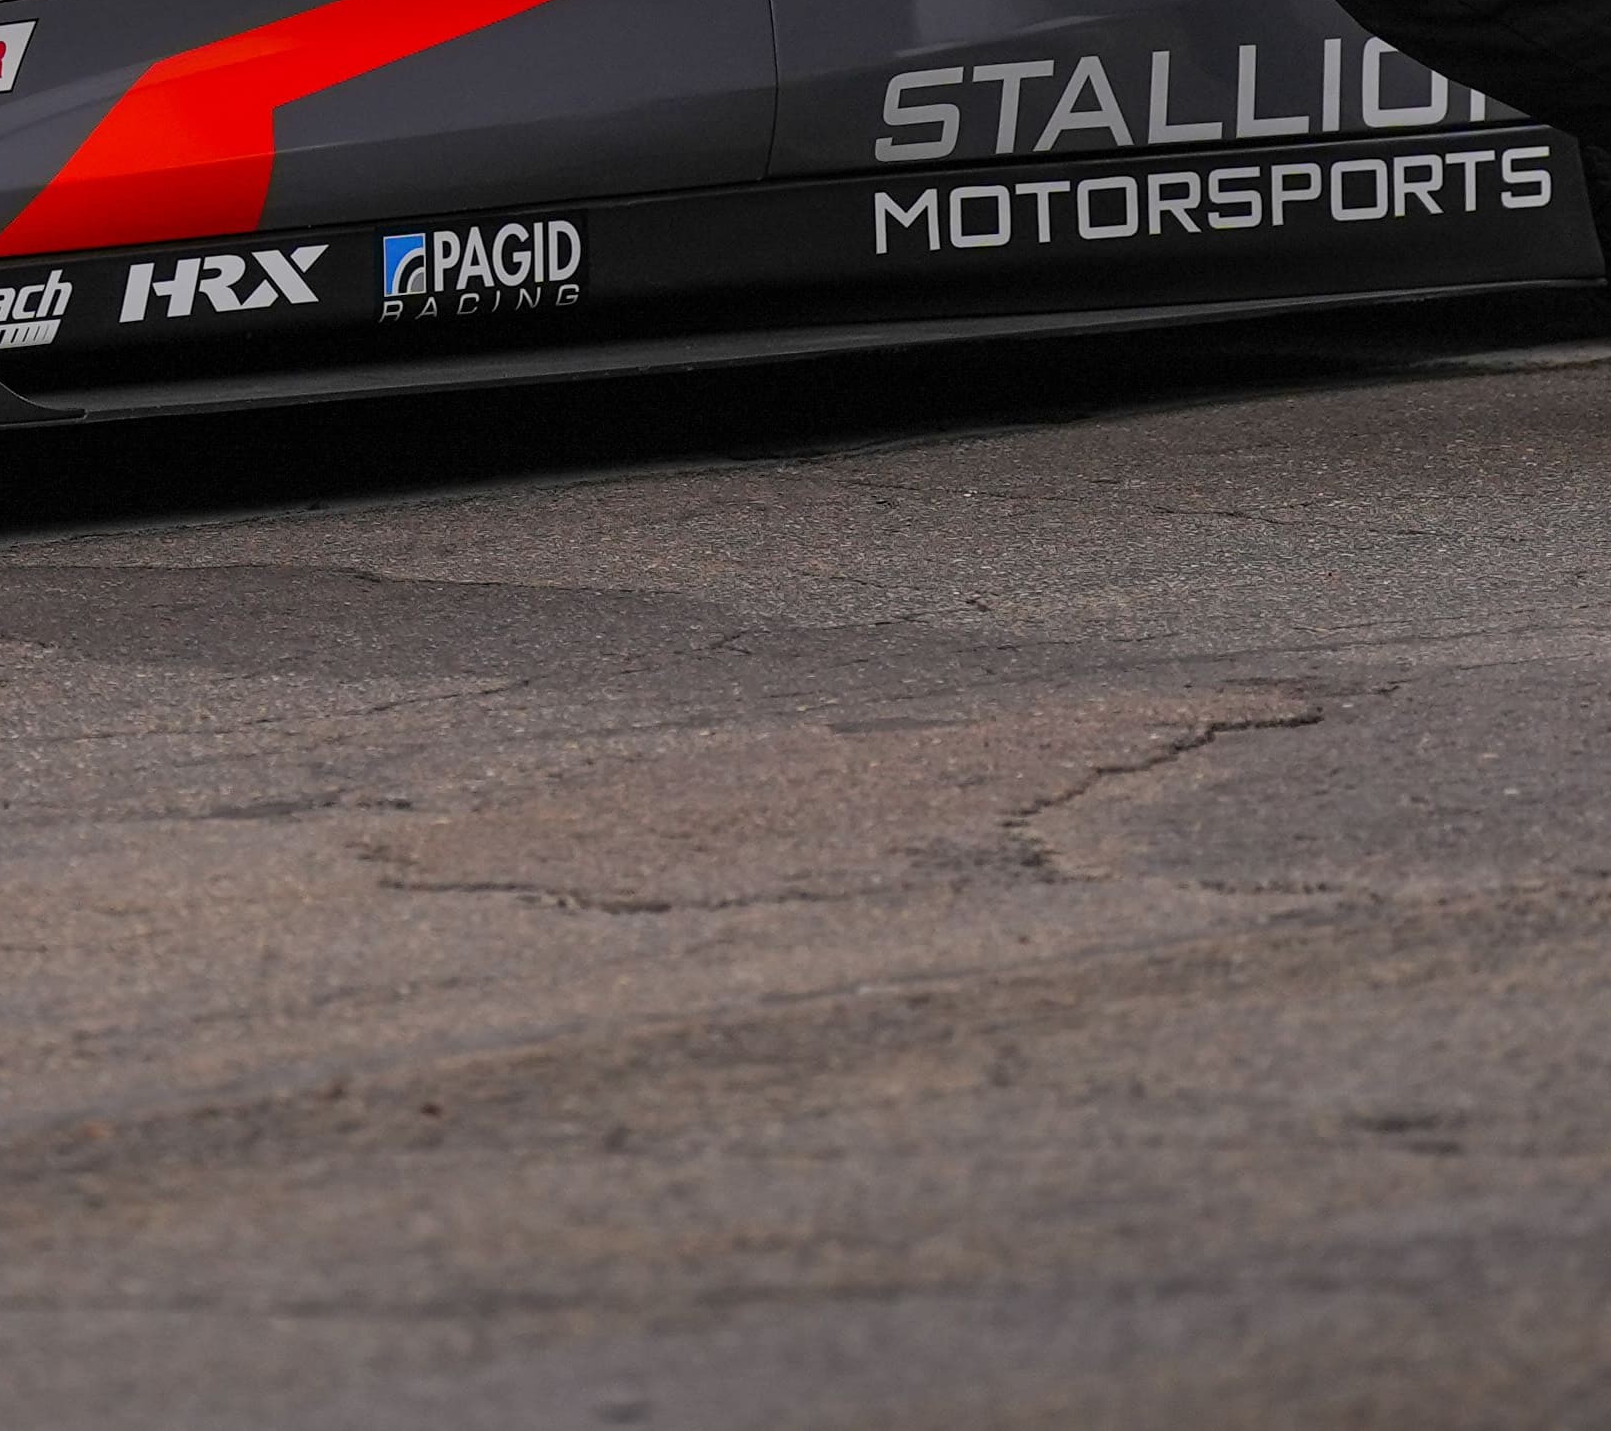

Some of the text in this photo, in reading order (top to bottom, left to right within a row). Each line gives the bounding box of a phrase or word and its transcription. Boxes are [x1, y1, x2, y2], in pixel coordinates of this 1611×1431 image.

[874, 36, 1487, 162] STALLIO
[874, 145, 1552, 255] MOTORSPORTS
[119, 243, 331, 325] HRX
[432, 219, 581, 293] PAGID
[378, 283, 581, 323] RACING
